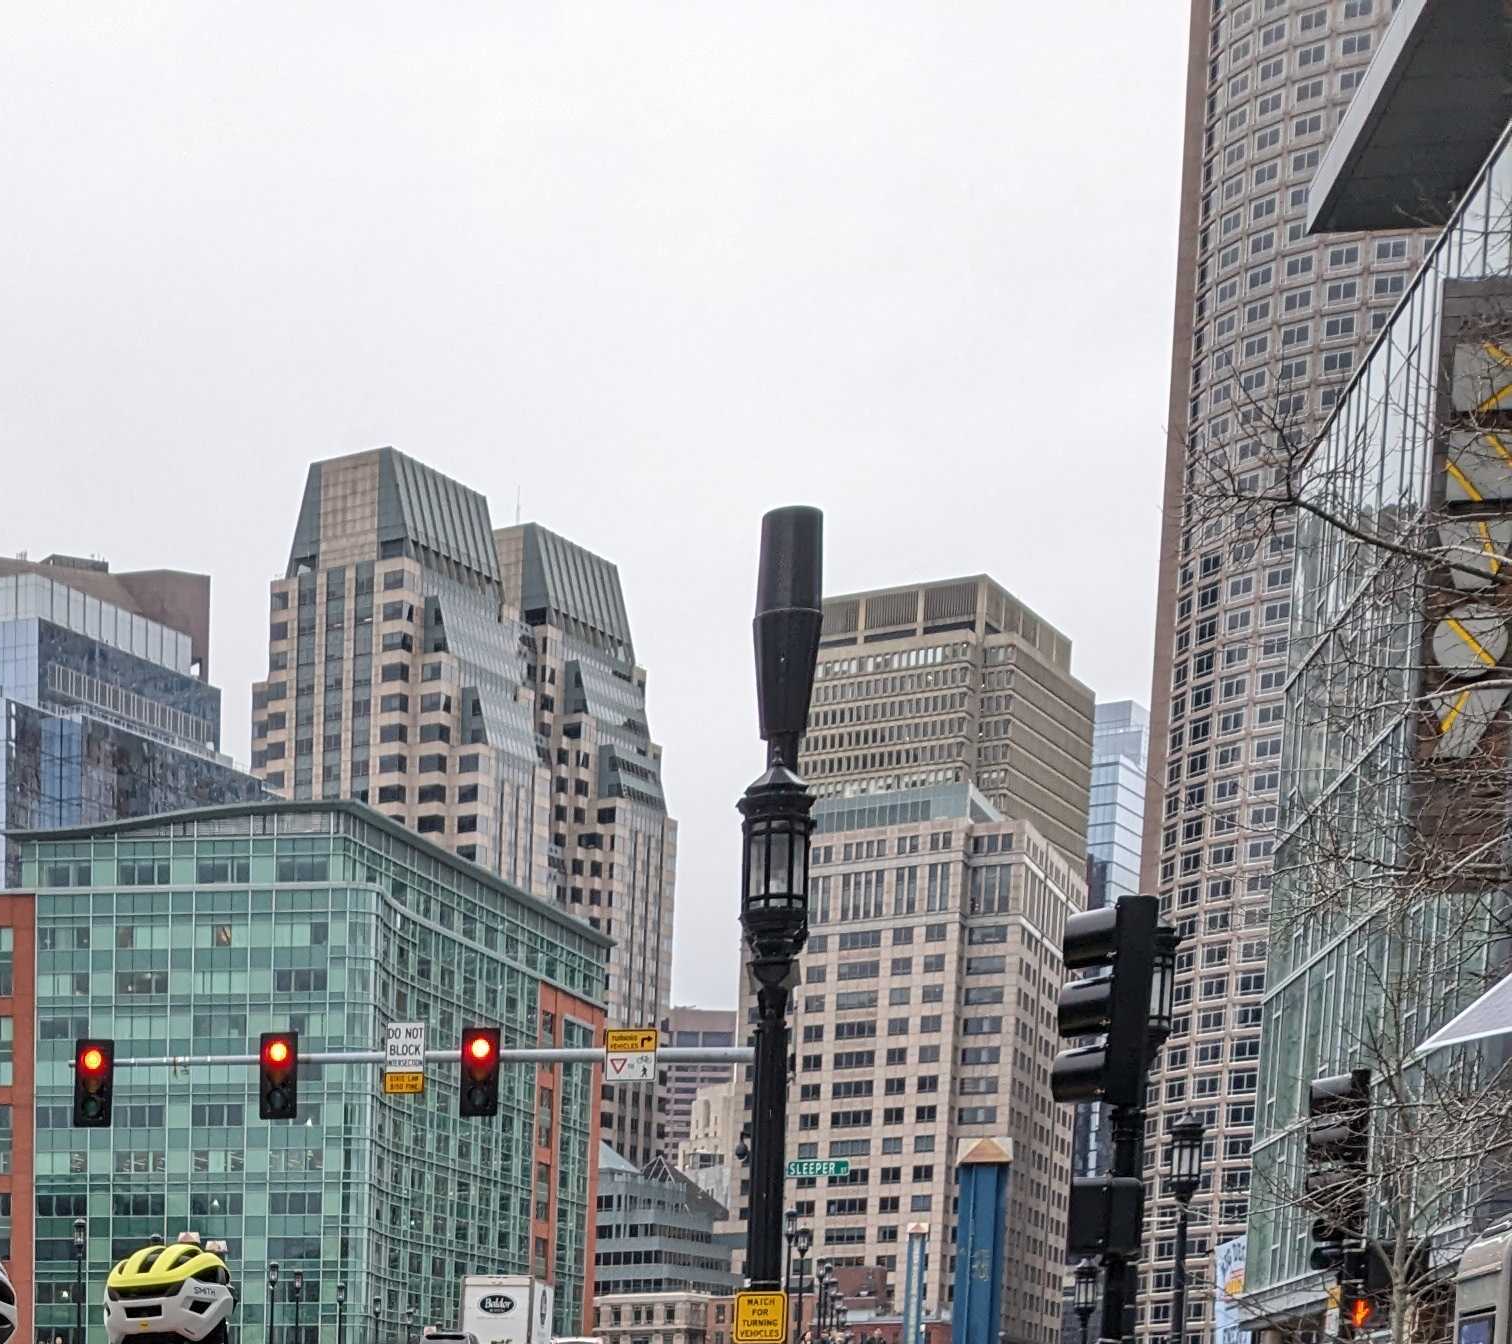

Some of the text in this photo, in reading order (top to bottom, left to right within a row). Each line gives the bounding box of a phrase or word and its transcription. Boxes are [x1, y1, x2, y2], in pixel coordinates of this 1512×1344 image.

[389, 1028, 423, 1039] DO NOT
[389, 1044, 421, 1055] BLOCK
[789, 1162, 835, 1175] SLEEPER
[193, 1286, 216, 1296] SMITH
[743, 1319, 778, 1327] TURNING
[740, 1330, 779, 1338] VEHICLES
